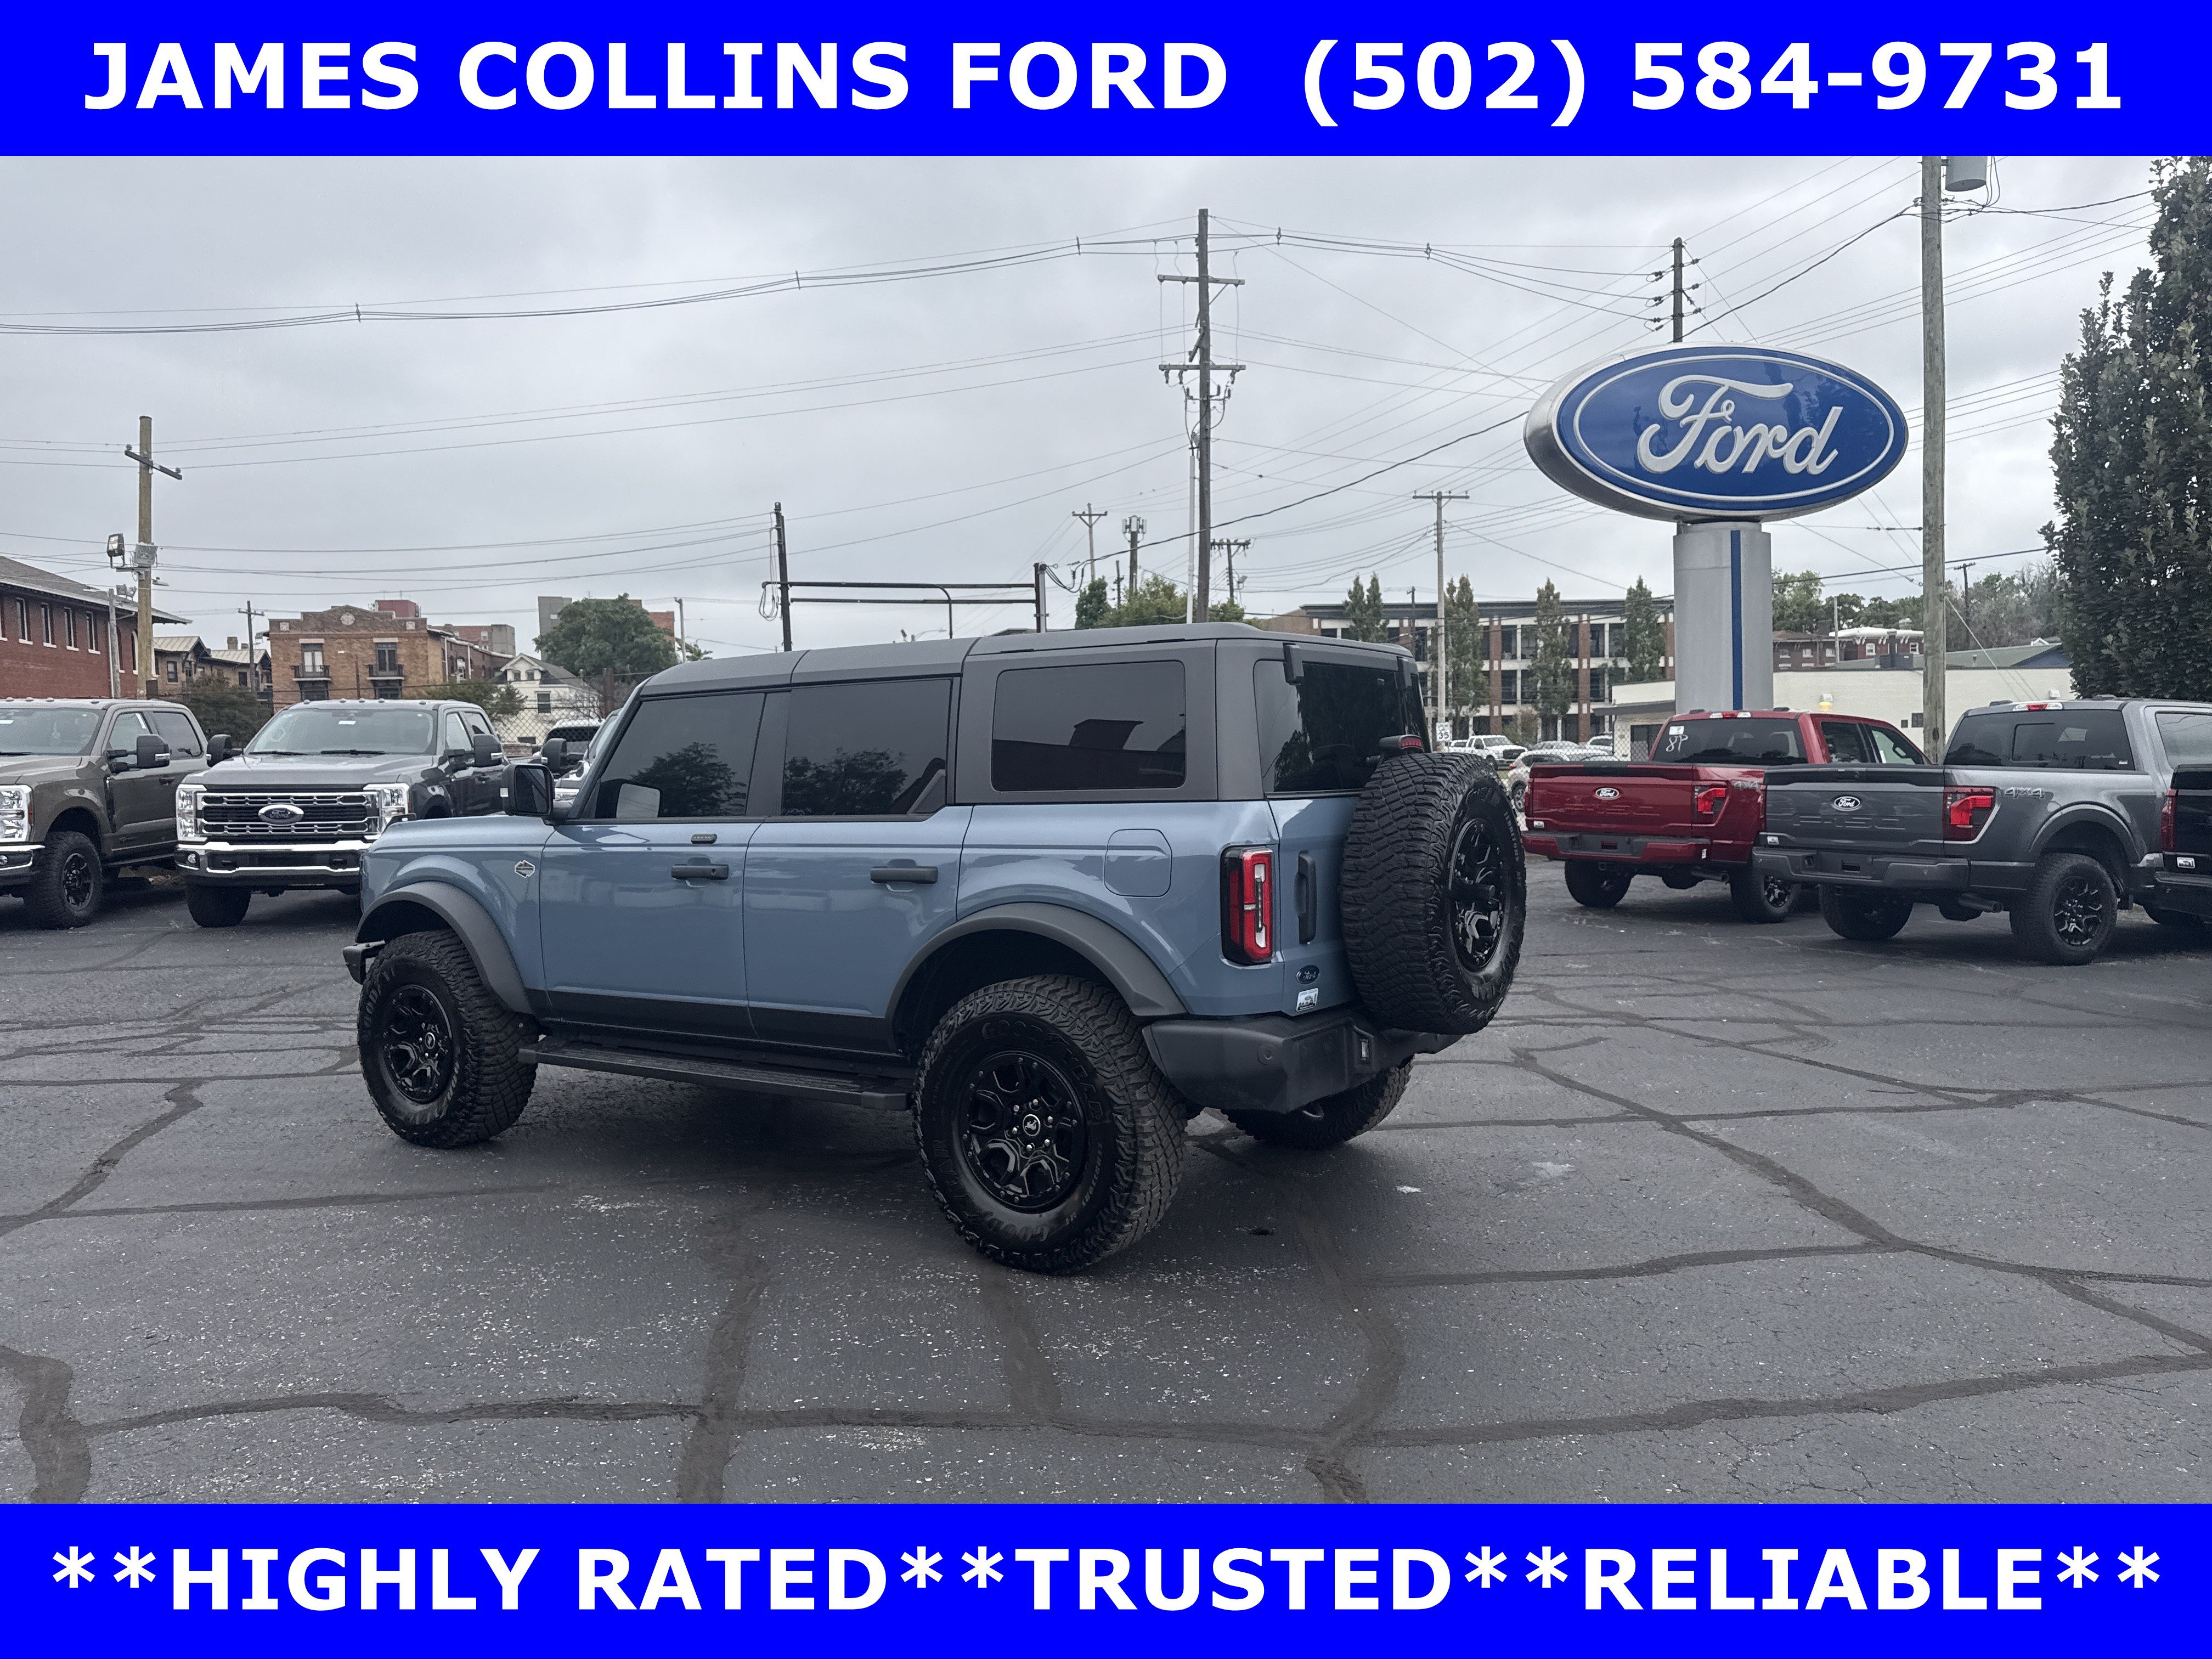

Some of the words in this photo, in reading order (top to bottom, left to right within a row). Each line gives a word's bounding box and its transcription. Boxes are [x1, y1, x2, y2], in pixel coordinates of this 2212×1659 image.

[1637, 375, 1843, 476] Ford
[1438, 731, 1449, 740] 35
[1599, 788, 1615, 797] Ford
[1838, 798, 1855, 807] Ford
[269, 810, 291, 819] Ford
[981, 1019, 1104, 1120] GOODYEAR
